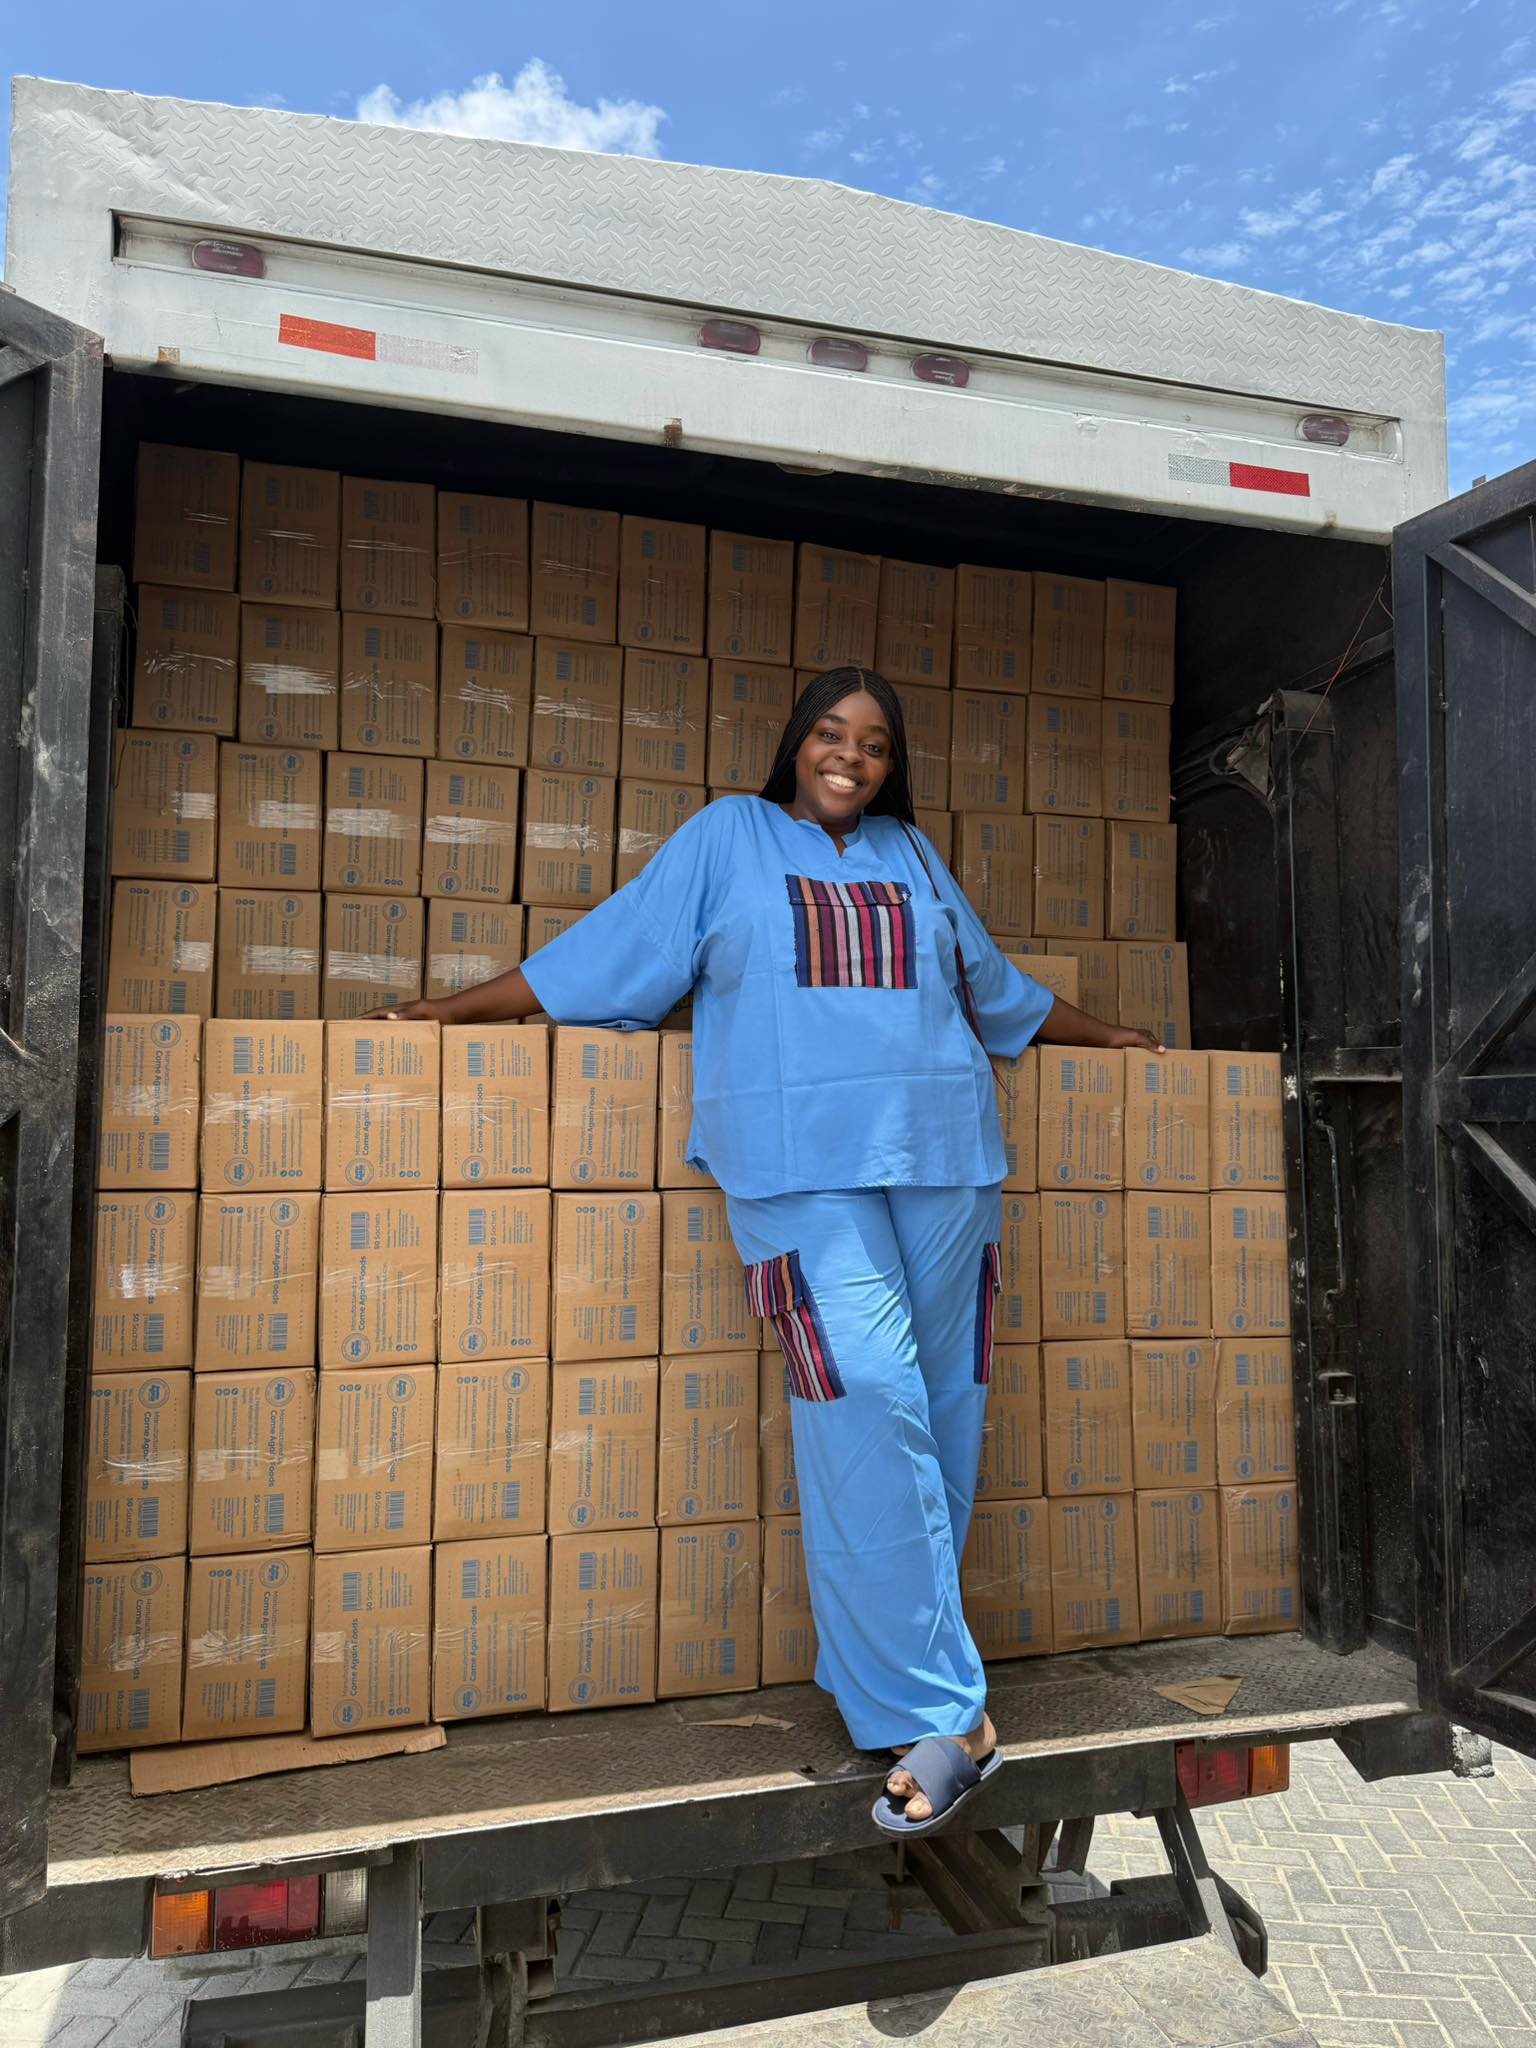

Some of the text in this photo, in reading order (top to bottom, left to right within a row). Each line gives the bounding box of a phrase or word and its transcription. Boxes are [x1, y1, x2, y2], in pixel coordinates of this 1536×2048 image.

[258, 1066, 264, 1074] 50
[378, 1067, 384, 1076] 50
[490, 1069, 496, 1077] 50
[603, 1072, 608, 1080] 50
[152, 1075, 161, 1100] Again
[588, 1111, 596, 1132] Again
[138, 1132, 144, 1140] 50
[374, 1241, 380, 1249] 50
[490, 1237, 496, 1245] 50
[272, 1254, 280, 1278] Again
[272, 1280, 280, 1304] Foods
[359, 1282, 367, 1305] Again
[476, 1278, 484, 1300] Again
[610, 1305, 616, 1313] 50
[132, 1313, 139, 1322] 50
[258, 1313, 264, 1321] 50
[600, 1407, 606, 1415] 50
[505, 1423, 513, 1446] Again
[389, 1432, 398, 1456] Again
[585, 1450, 593, 1473] Again
[268, 1462, 276, 1487] Foods
[389, 1458, 397, 1482] Foods
[492, 1482, 498, 1490] 50
[254, 1494, 260, 1503] 50
[375, 1492, 381, 1500] 50
[127, 1497, 133, 1507] 50
[485, 1590, 491, 1598] 50
[366, 1602, 373, 1611] 50
[260, 1618, 269, 1642] Again
[351, 1646, 359, 1670] Again
[117, 1690, 124, 1698] 50
[243, 1680, 251, 1717] 50 Sachets
